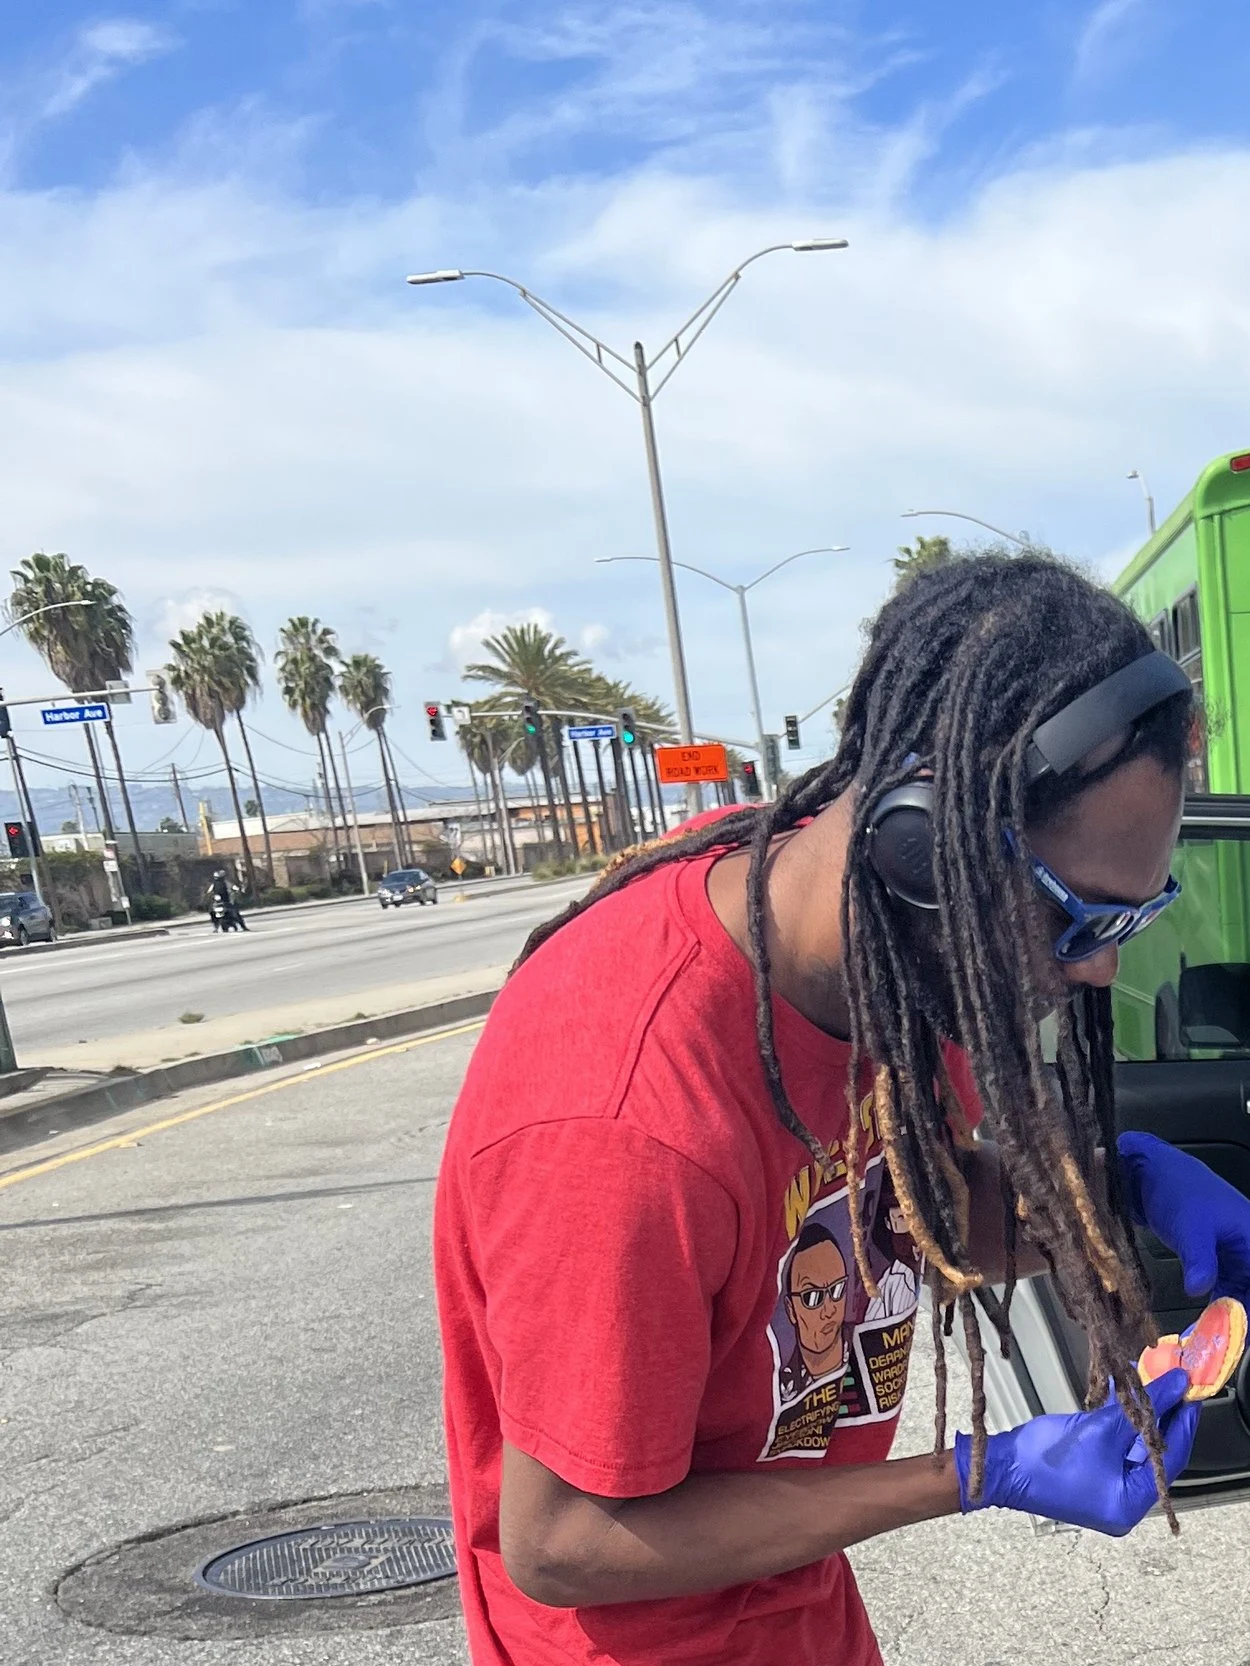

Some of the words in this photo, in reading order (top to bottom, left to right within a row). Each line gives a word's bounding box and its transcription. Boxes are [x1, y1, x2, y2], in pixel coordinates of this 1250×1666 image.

[45, 711, 80, 722] Harbor
[84, 708, 103, 718] Ave
[681, 751, 701, 761] END
[666, 766, 691, 777] ROAD
[693, 765, 719, 775] WORK
[803, 1383, 837, 1410] THE
[778, 1401, 841, 1434] ELECTRIFYING
